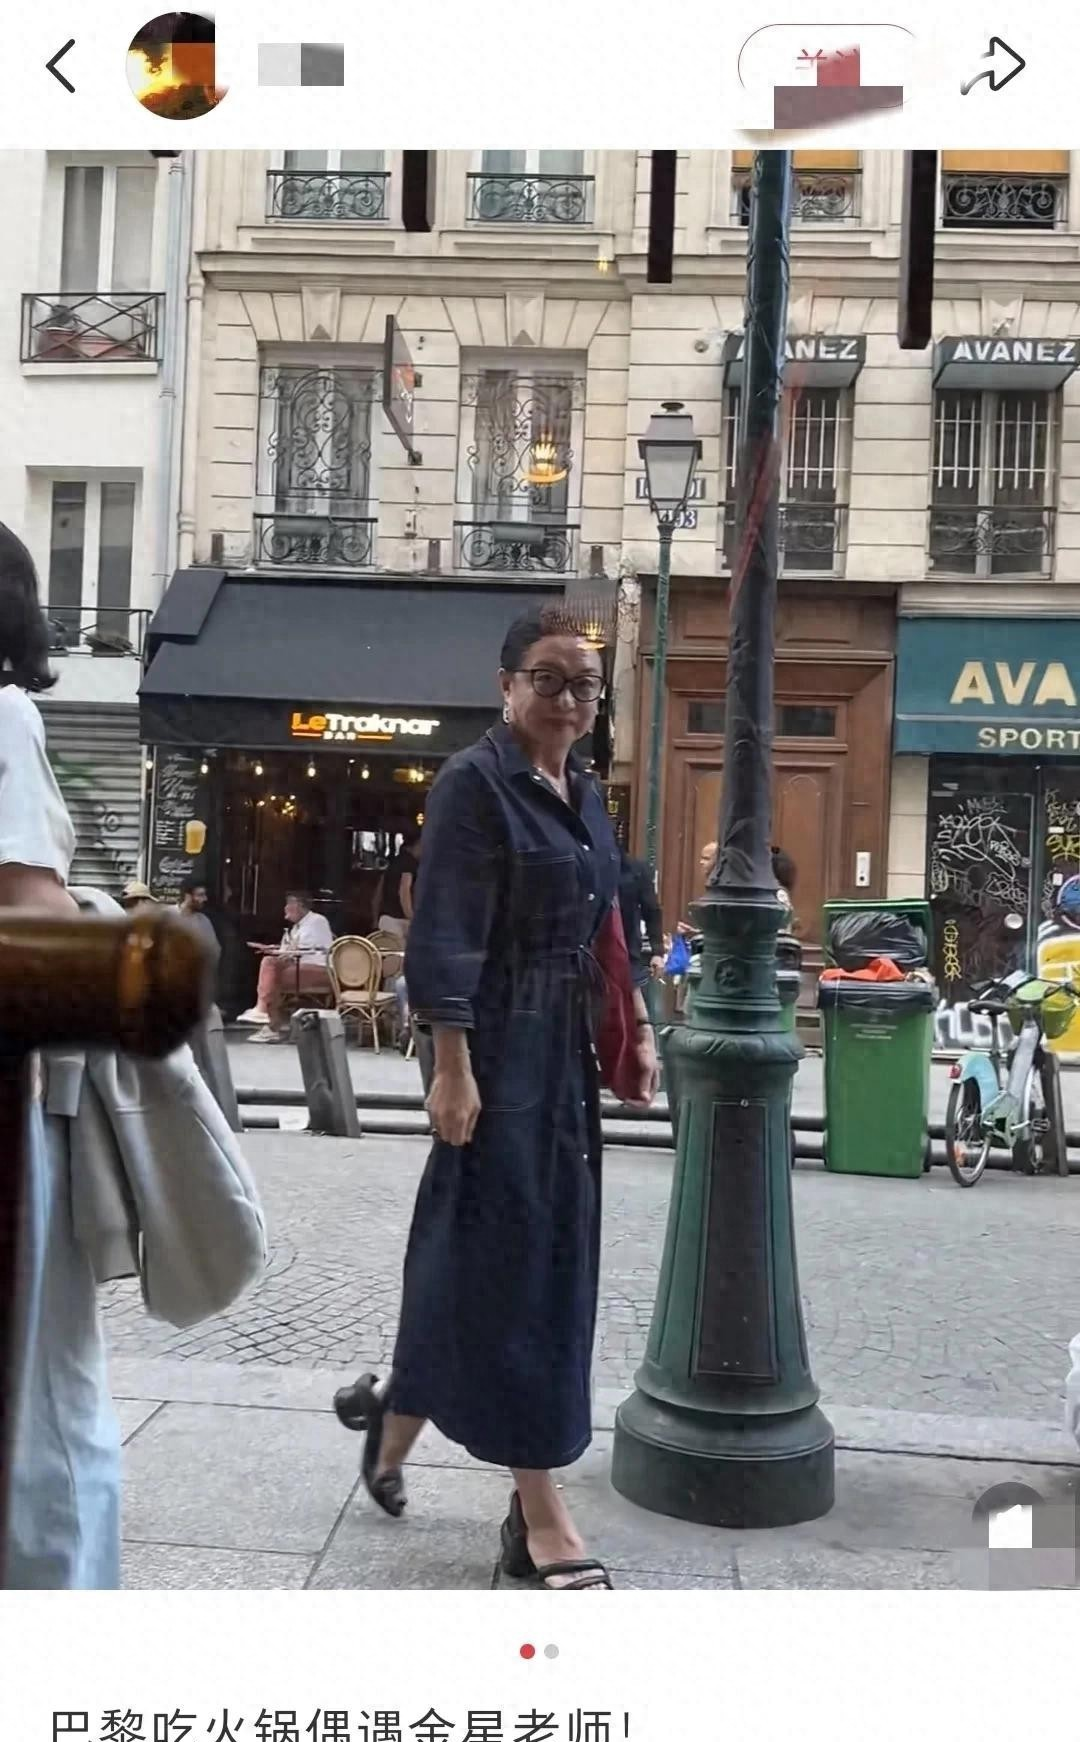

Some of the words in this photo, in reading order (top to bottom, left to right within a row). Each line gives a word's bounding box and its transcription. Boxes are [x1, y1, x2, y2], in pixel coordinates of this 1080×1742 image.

[736, 340, 858, 359] NEZ
[952, 341, 1076, 362] AVANEZ
[949, 661, 1077, 706] AVA
